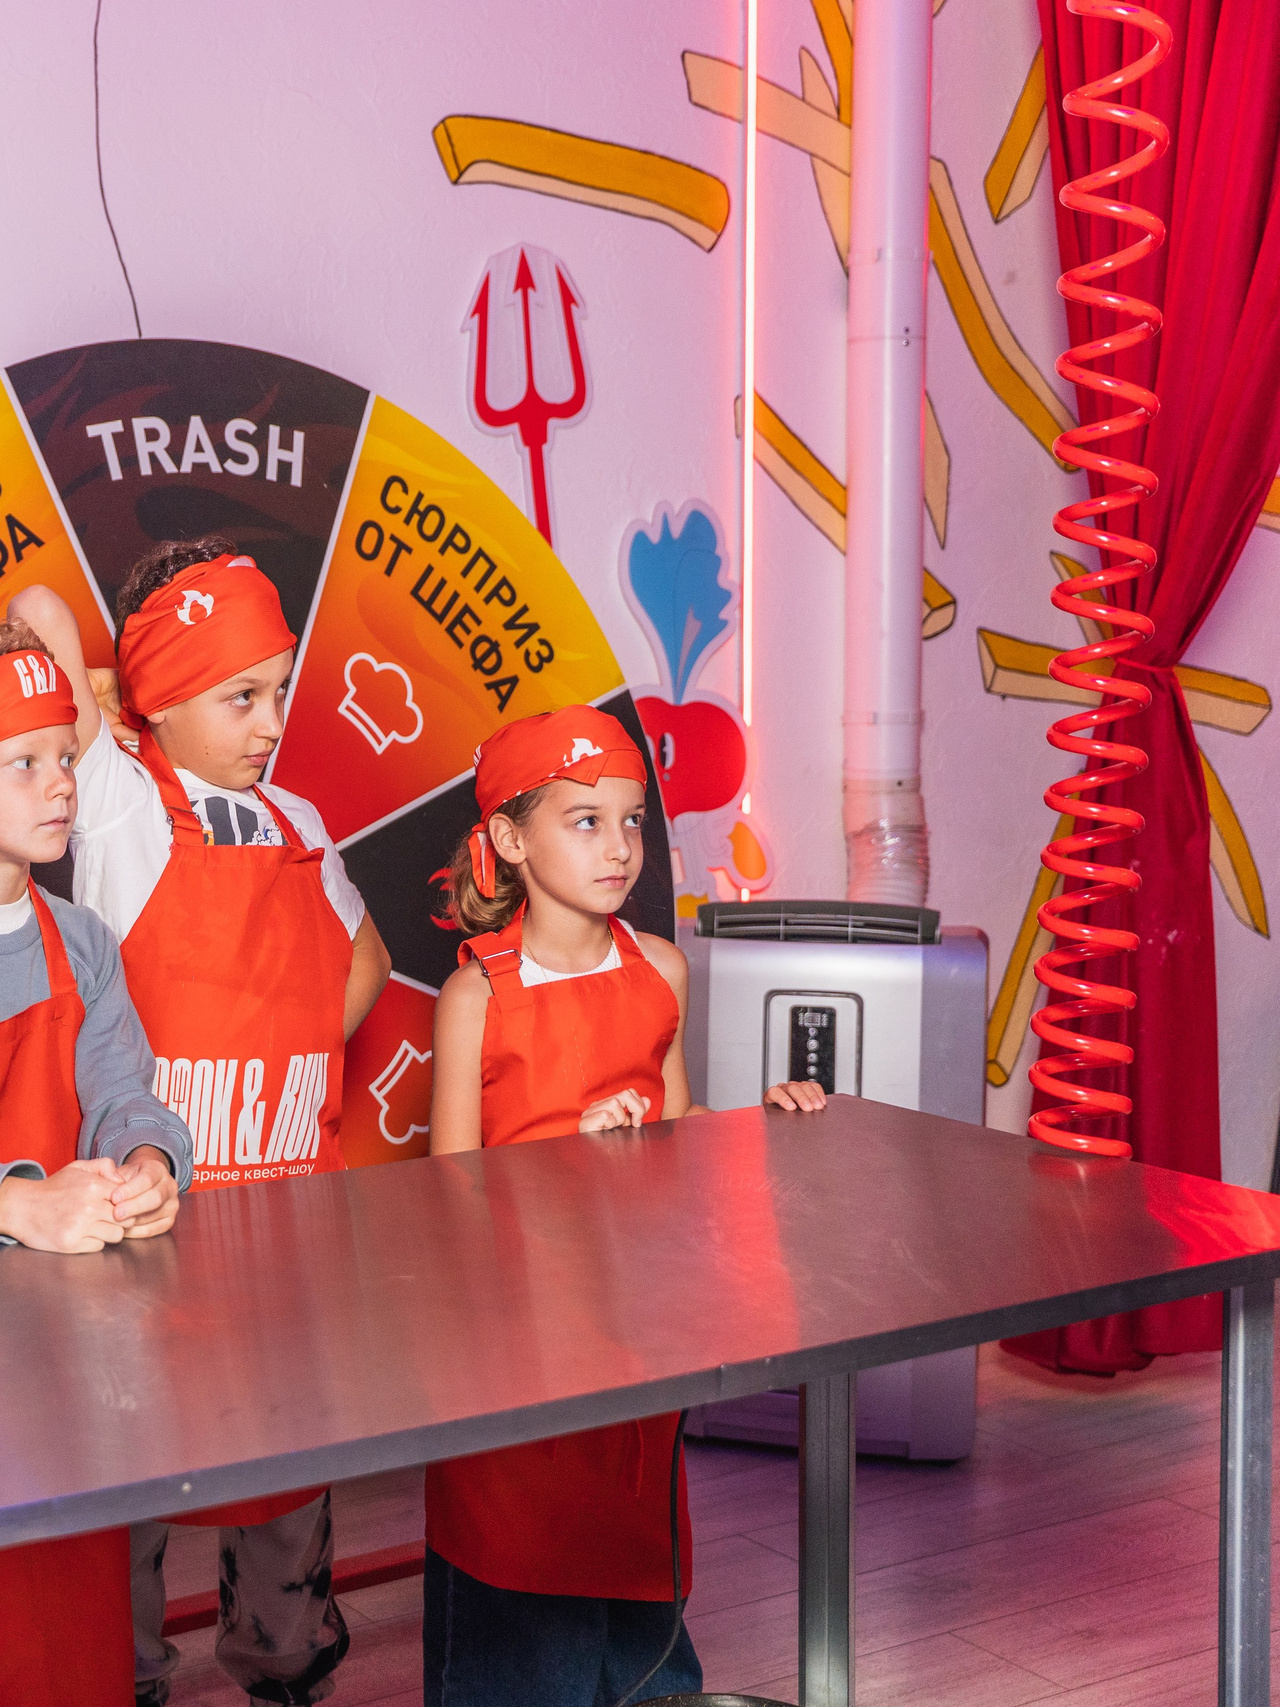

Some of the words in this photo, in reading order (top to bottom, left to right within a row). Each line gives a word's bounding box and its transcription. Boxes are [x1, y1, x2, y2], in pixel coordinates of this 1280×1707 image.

[86, 415, 305, 487] TRASH
[355, 520, 413, 577] ОТ
[410, 564, 520, 713] ШЕФА
[380, 475, 554, 673] СЮРПРИЗ
[235, 1059, 266, 1165] &
[263, 1053, 330, 1163] RUN
[192, 1167, 240, 1183] арное
[244, 1163, 315, 1180] квест-шоу
